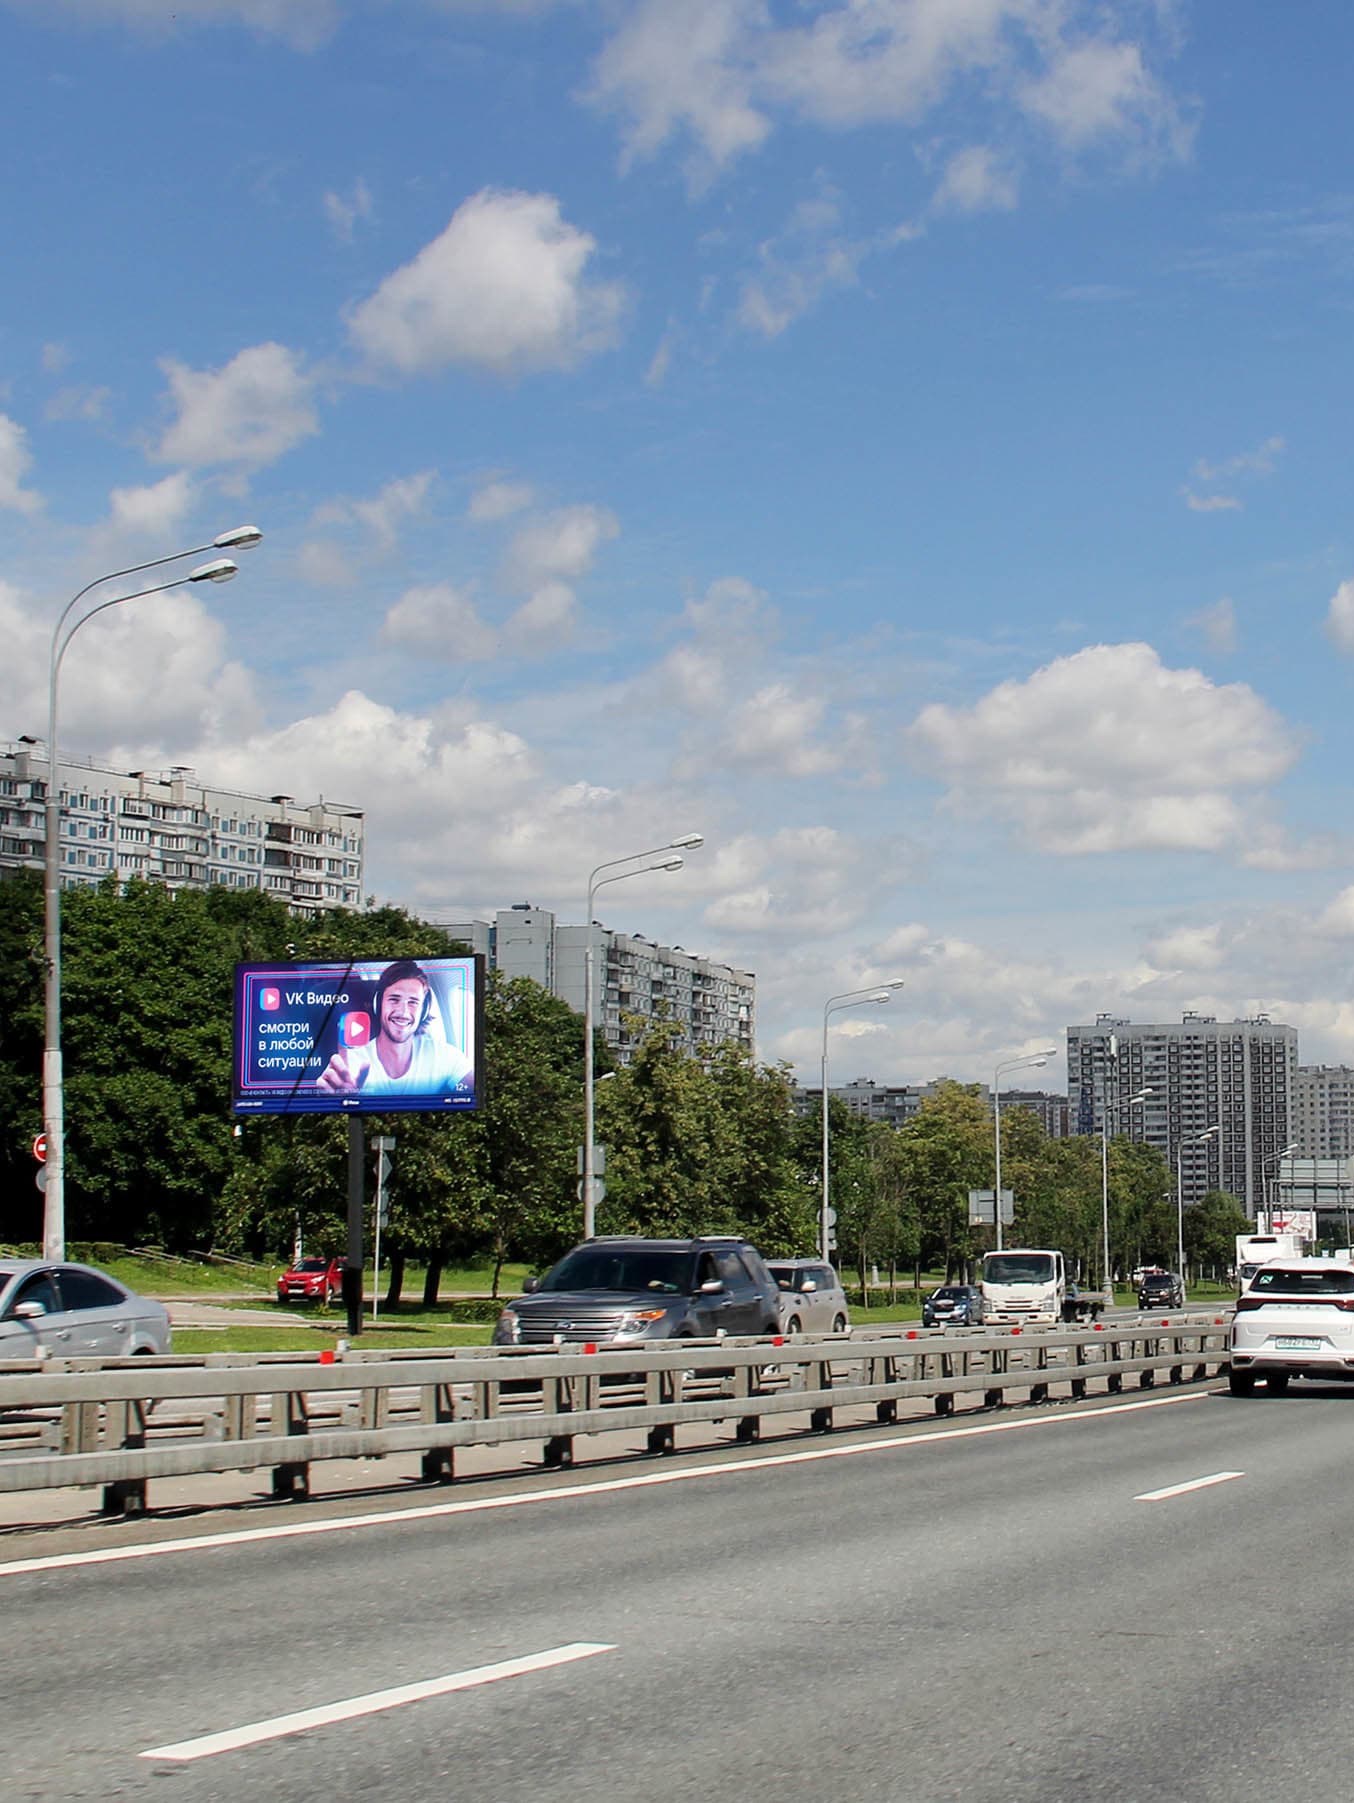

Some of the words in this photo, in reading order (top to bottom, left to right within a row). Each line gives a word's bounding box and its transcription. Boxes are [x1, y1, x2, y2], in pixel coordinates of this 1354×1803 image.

[285, 992, 304, 1005] VK
[307, 991, 349, 1006] Видео
[258, 1022, 310, 1037] смотри
[258, 1040, 267, 1051] в
[269, 1036, 314, 1050] любой
[257, 1056, 322, 1071] ситуации
[455, 1082, 468, 1092] 12+
